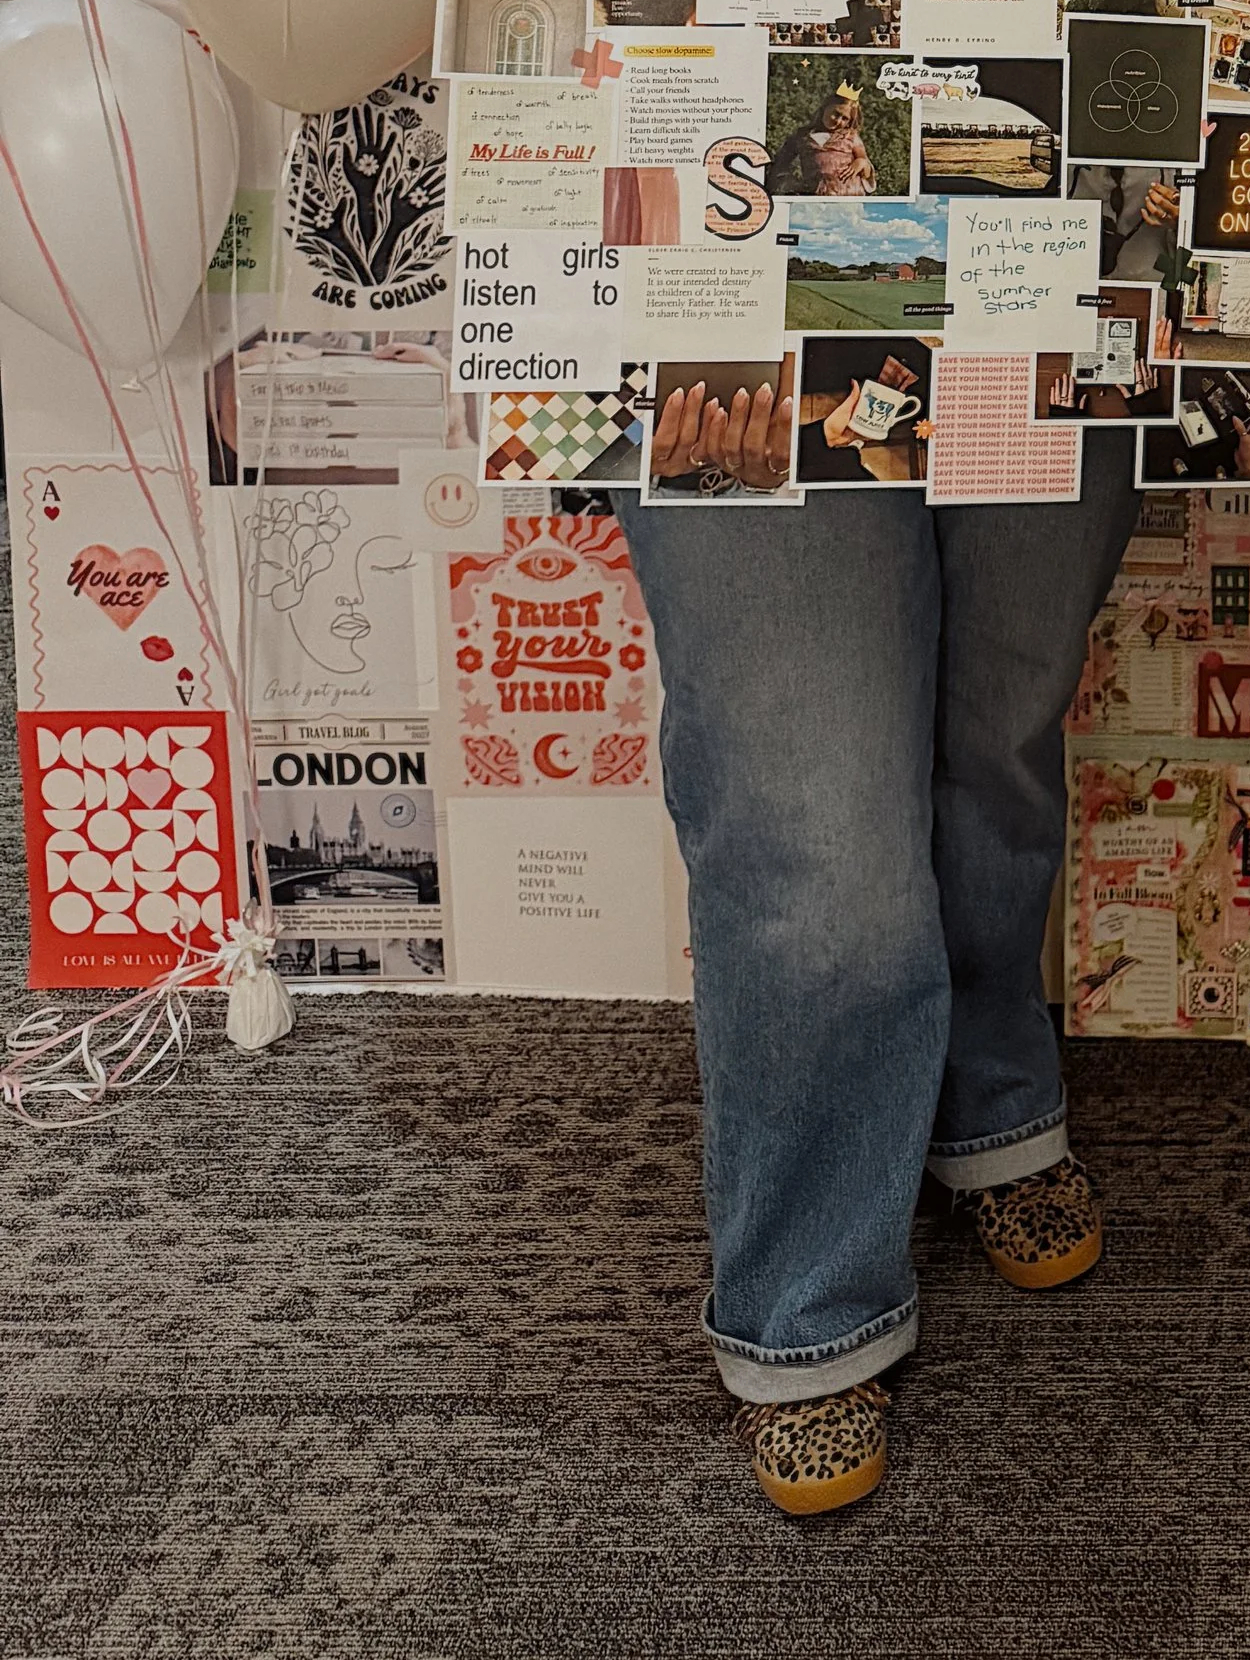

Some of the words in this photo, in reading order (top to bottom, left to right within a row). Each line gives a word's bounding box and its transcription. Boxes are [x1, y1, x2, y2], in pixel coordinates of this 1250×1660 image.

[1220, 212, 1249, 233] ON
[465, 243, 508, 269] hot
[563, 242, 619, 275] girls
[312, 282, 357, 308] ARE
[370, 274, 447, 310] COMING
[463, 280, 536, 306] listen
[594, 282, 618, 306] to
[461, 322, 513, 342] one
[459, 354, 577, 380] direction
[67, 559, 124, 590] You
[126, 567, 168, 588] are
[100, 589, 143, 608] ace
[492, 593, 603, 627] TRUST
[492, 631, 611, 678] your
[498, 682, 606, 712] VISION
[298, 726, 341, 740] TRAVEL
[343, 725, 370, 739] BLOG
